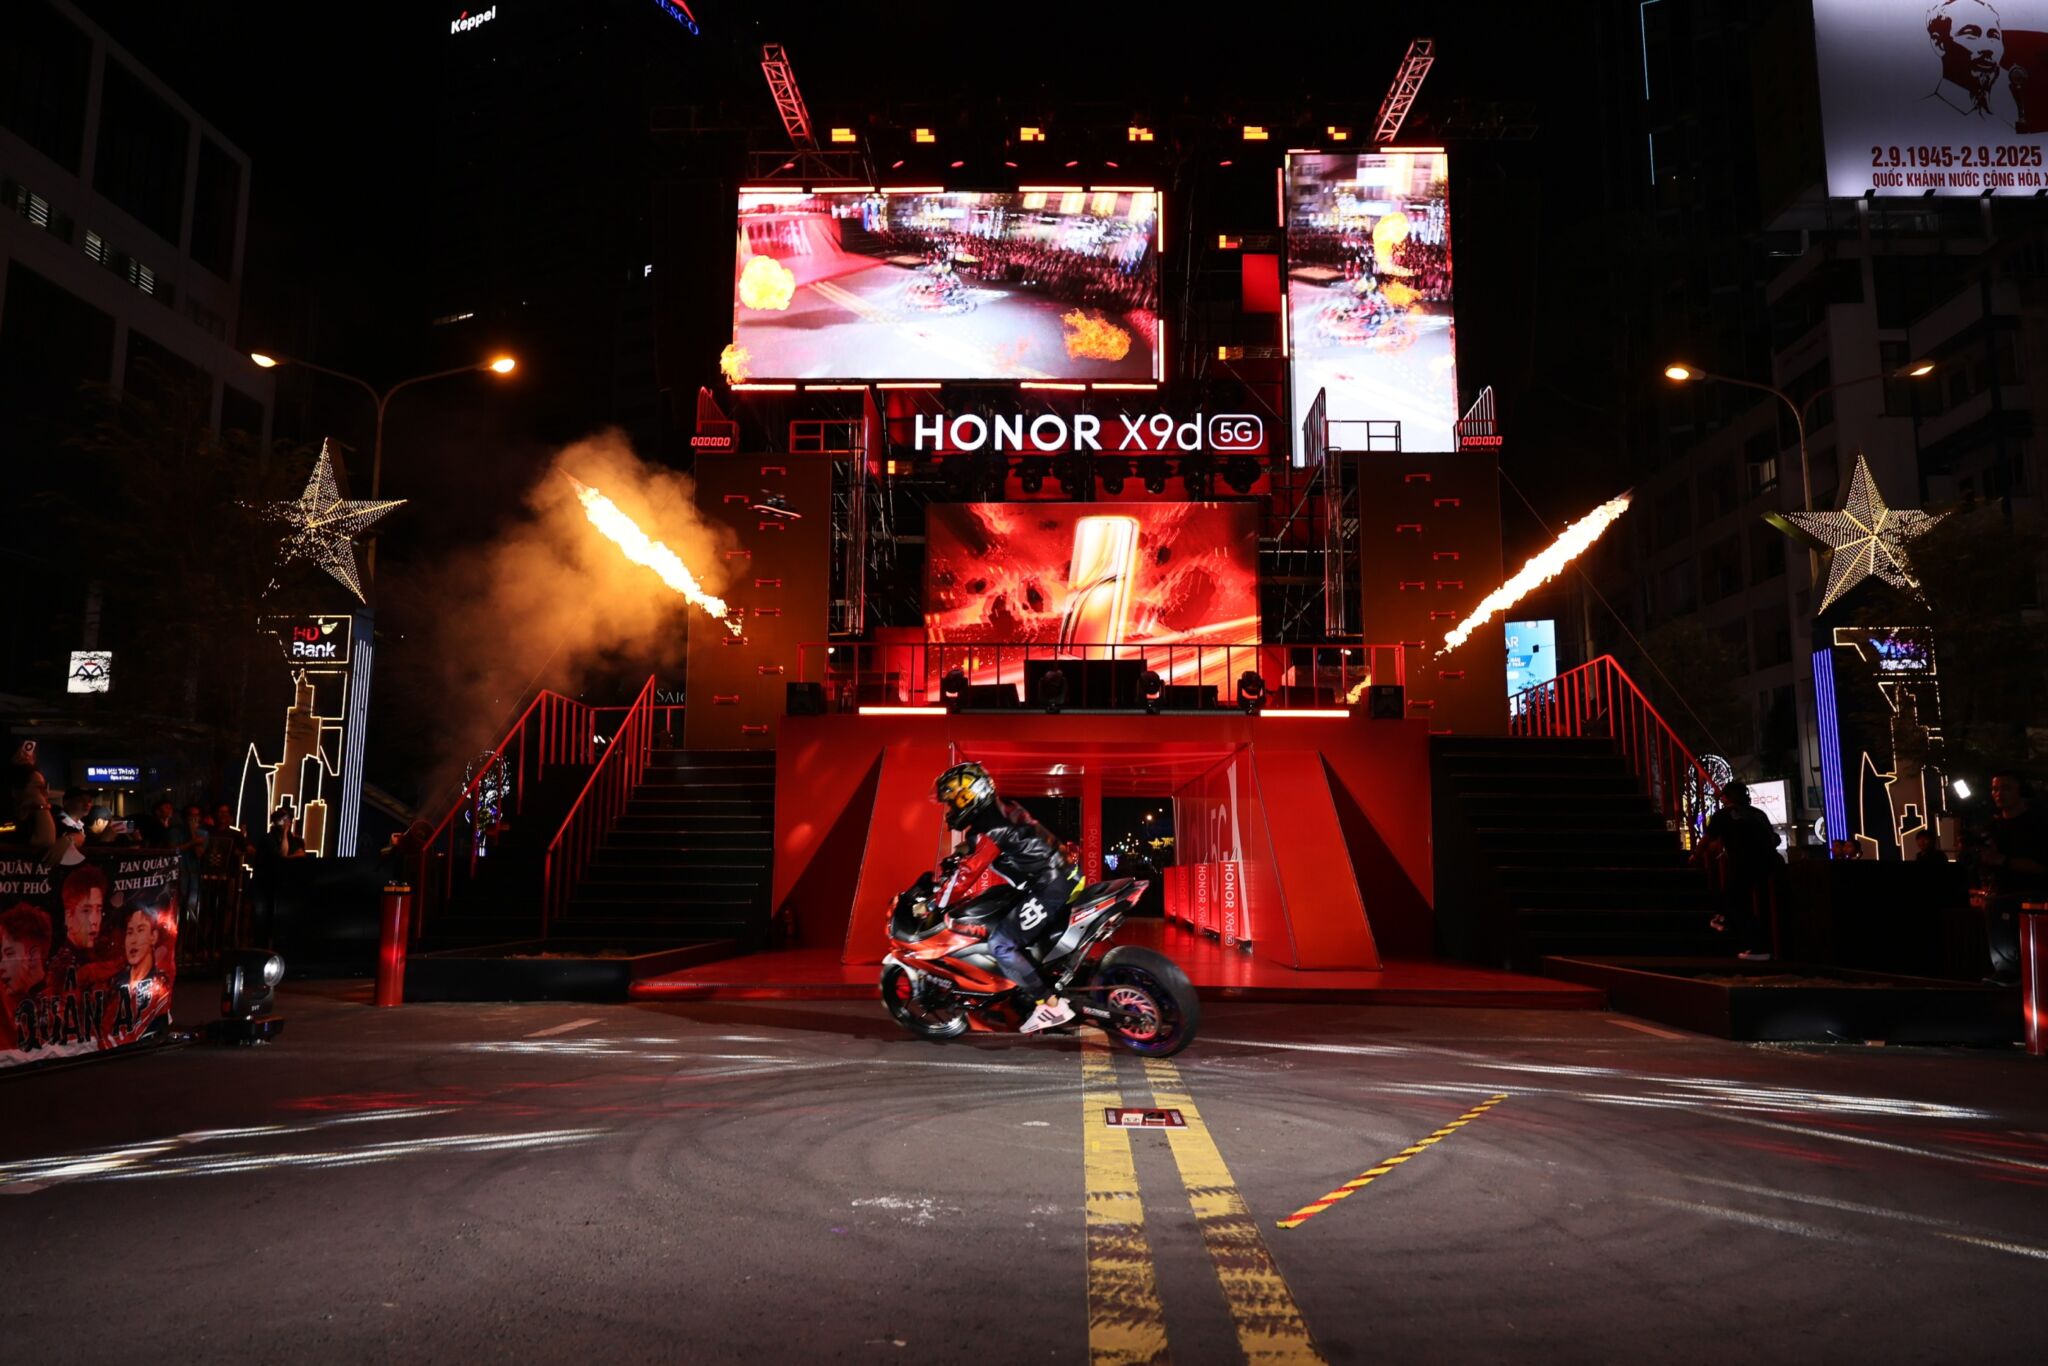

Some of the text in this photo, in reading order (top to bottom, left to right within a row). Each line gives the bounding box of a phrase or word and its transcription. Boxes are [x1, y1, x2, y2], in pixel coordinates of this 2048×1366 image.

[450, 5, 497, 35] Keppel
[1871, 145, 2043, 168] 2.9.1945-2.9.2025
[1872, 168, 1903, 188] QUỐC
[1906, 169, 1945, 187] KHÁNH
[1948, 169, 1980, 187] NƯỚC
[1983, 169, 2015, 189] CỘNG
[2018, 168, 2041, 187] HÒA
[914, 412, 1256, 451] HONOR X9d 5G
[292, 641, 337, 658] Bank
[119, 860, 141, 873] FAN
[1087, 850, 1097, 886] ONOR
[113, 877, 141, 892] XINH
[1198, 865, 1207, 903] HONOR
[1224, 863, 1235, 909] HONOR
[1224, 911, 1235, 933] X9d
